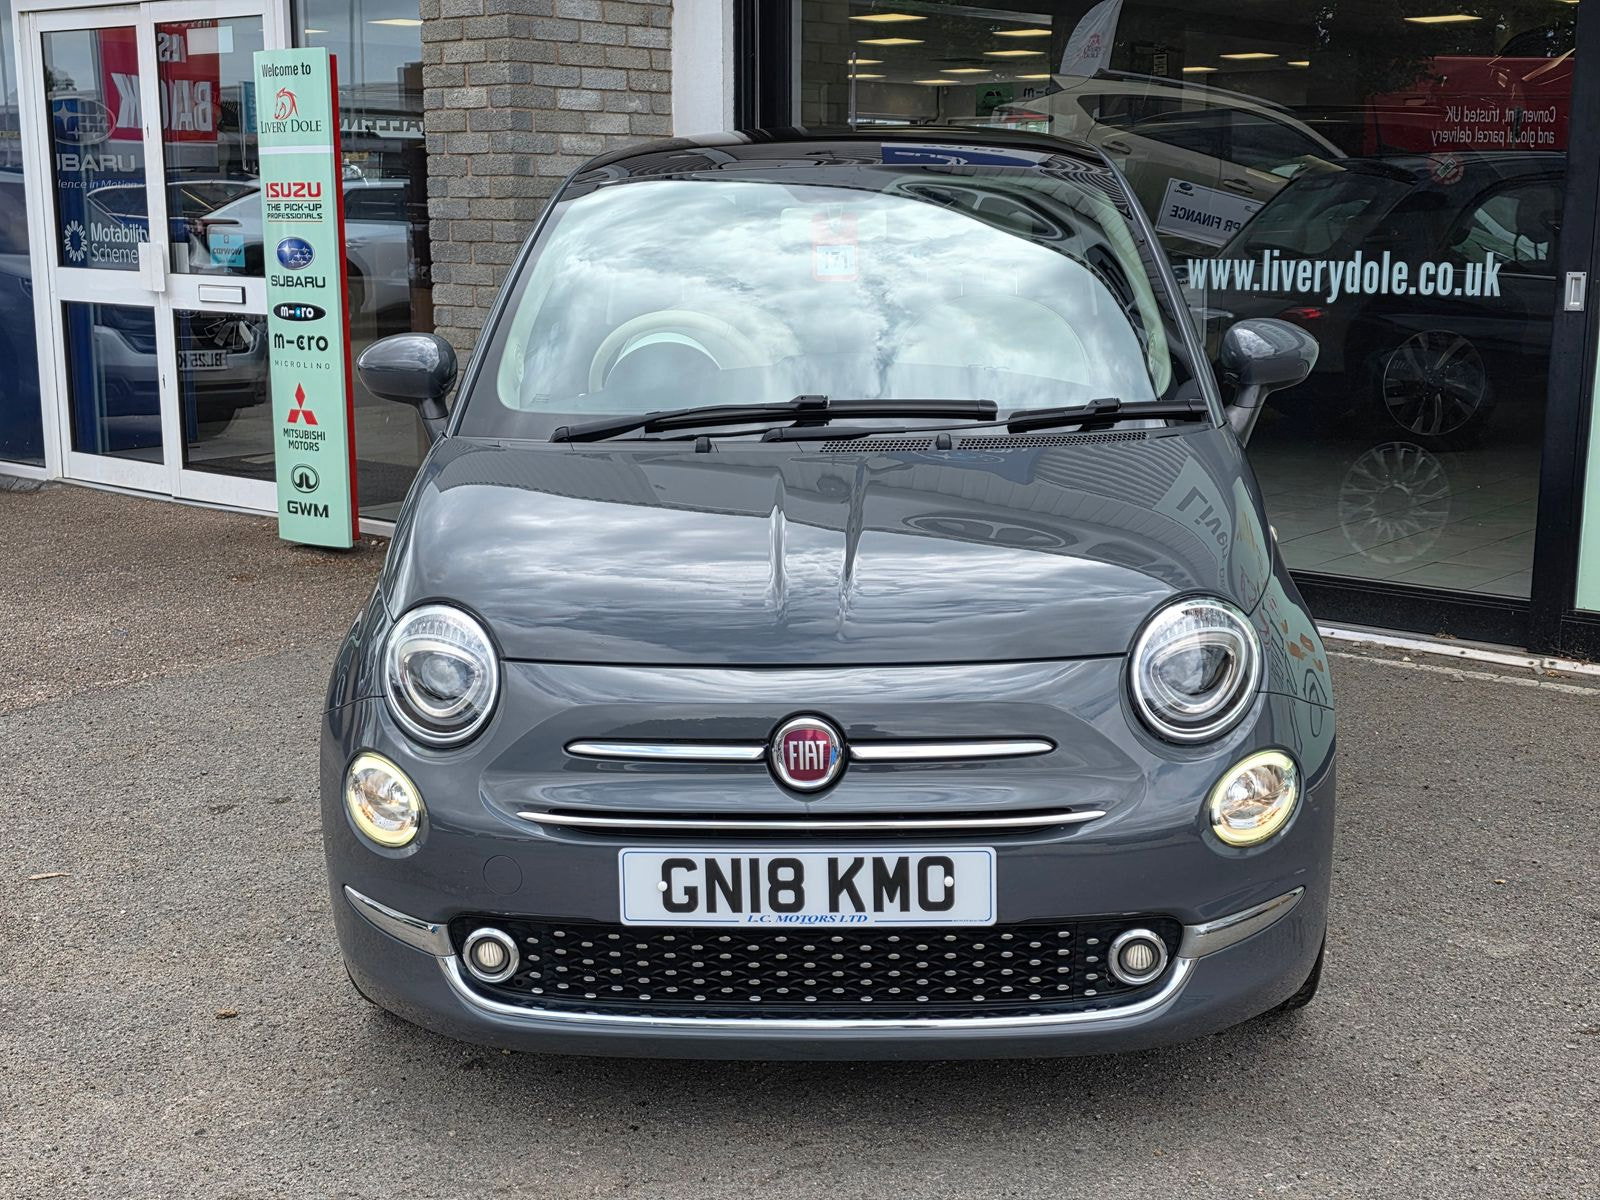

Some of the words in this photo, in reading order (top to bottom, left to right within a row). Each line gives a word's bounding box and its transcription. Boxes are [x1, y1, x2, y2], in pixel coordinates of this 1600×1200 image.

[261, 64, 298, 77] Welcome
[301, 62, 311, 75] to
[260, 121, 287, 134] LIVERY
[291, 119, 322, 133] DOLE
[265, 182, 322, 198] ISUZU
[267, 203, 281, 211] THE
[285, 203, 322, 212] PICK-UP
[90, 221, 150, 245] Motability
[91, 243, 139, 264] Scheme
[271, 275, 326, 288] SUBARU
[1187, 249, 1503, 304] www.liverydole.co.uk
[274, 360, 331, 371] MICROLINO
[283, 427, 326, 441] MITSUBISHI
[288, 440, 320, 452] MOTORS
[287, 500, 330, 518] GWM
[788, 740, 827, 771] FIAT
[660, 857, 806, 914] GN18
[827, 855, 956, 913] KMO
[747, 914, 772, 923] L.C.
[774, 914, 837, 923] MOTORS
[839, 914, 869, 923] LTD
